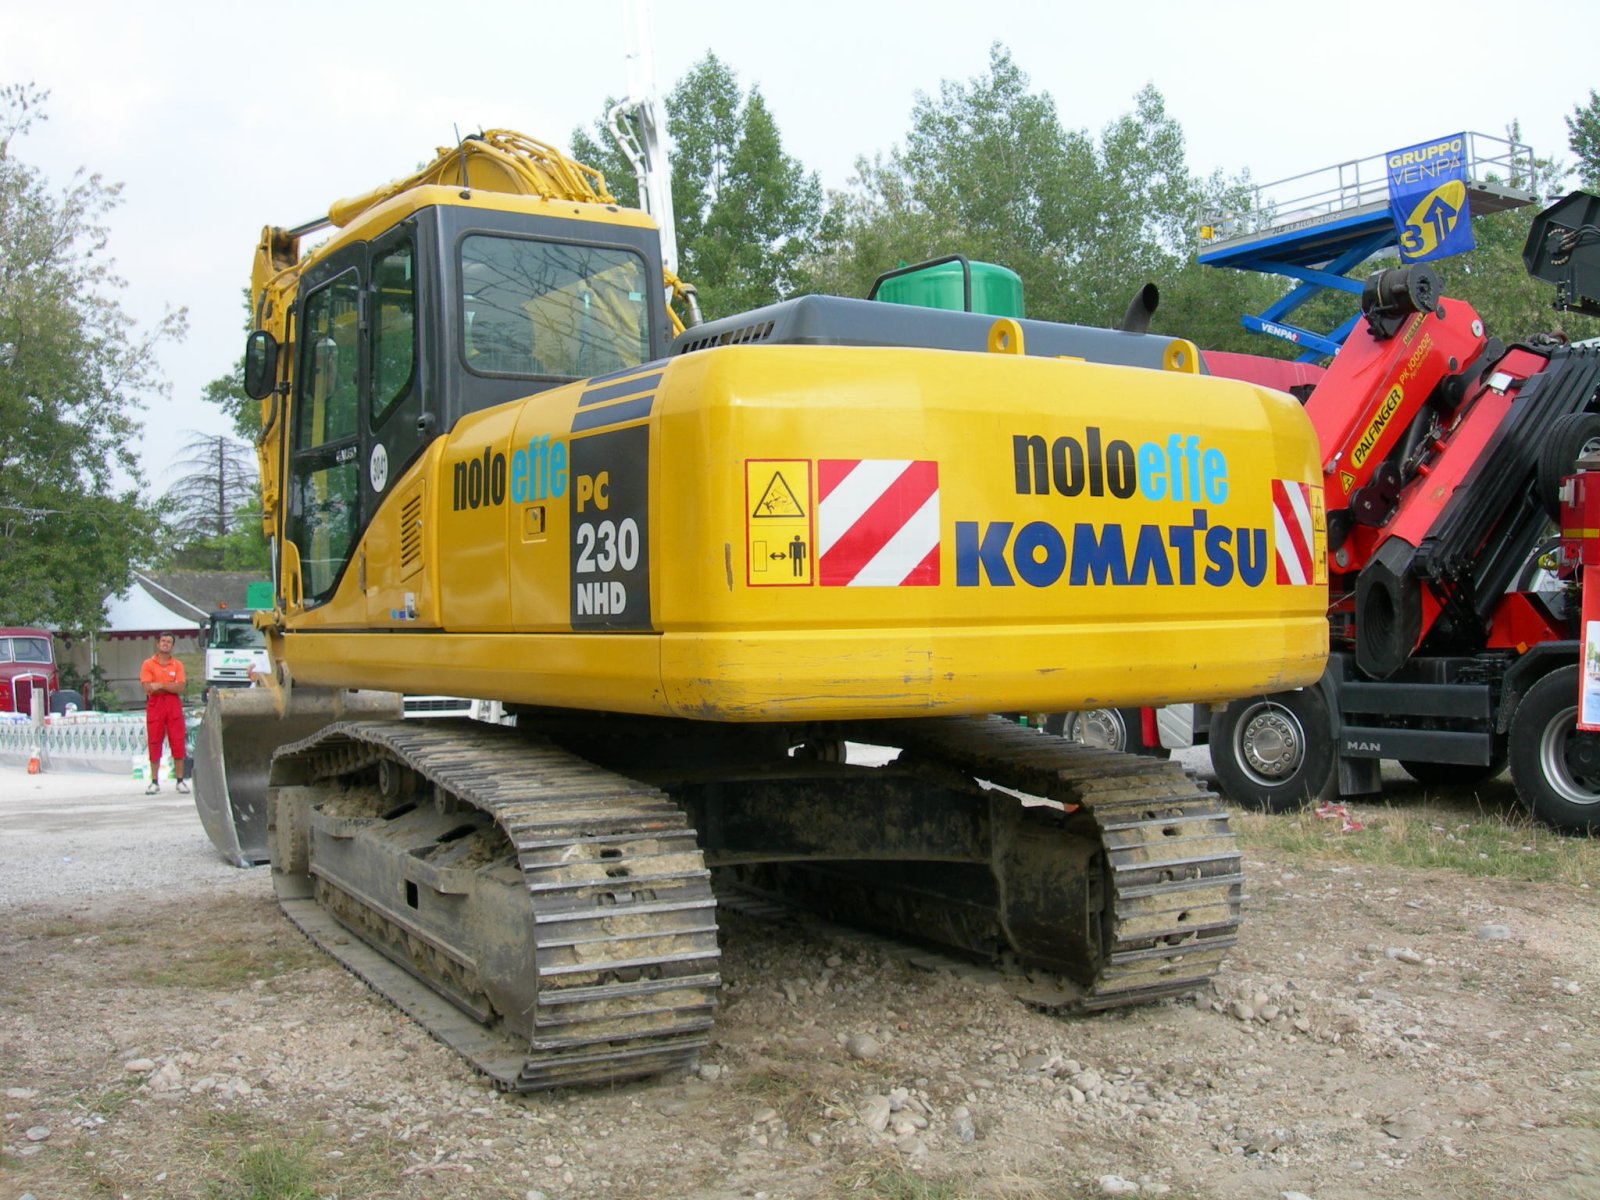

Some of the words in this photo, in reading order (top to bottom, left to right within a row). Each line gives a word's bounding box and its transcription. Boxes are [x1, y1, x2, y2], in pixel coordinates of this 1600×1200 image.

[1389, 139, 1462, 169] GRUPPO
[1392, 155, 1461, 186] VENPA
[1261, 322, 1295, 340] VENPA
[1399, 368, 1410, 385] PK
[1407, 332, 1431, 371] 100002
[1354, 389, 1401, 464] PALFINGER
[1013, 426, 1229, 505] noloeffe
[577, 471, 609, 513] PC
[576, 517, 640, 573] 230
[955, 508, 1267, 587] KOMATSU
[577, 581, 627, 616] NHD
[1347, 741, 1381, 752] MAN
